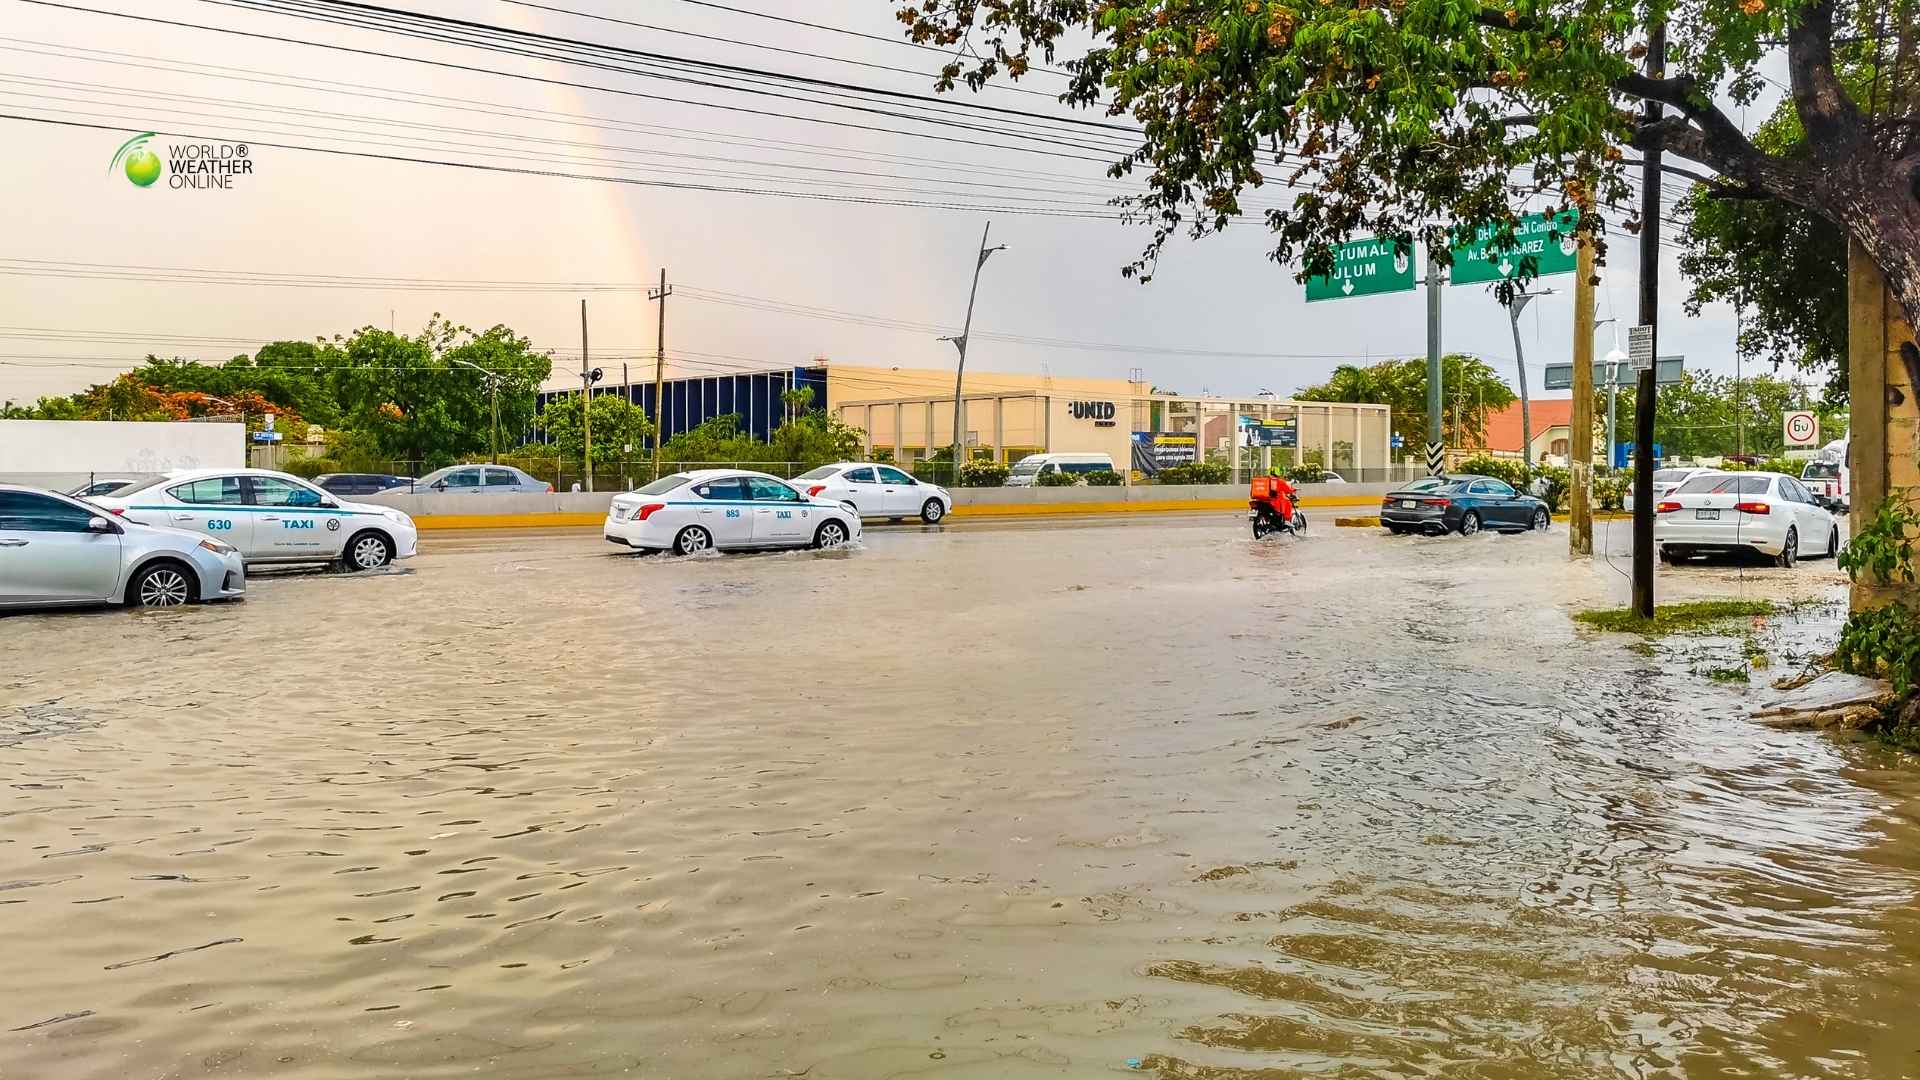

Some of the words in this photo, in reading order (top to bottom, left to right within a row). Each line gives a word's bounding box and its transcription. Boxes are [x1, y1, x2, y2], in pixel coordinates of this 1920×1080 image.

[1333, 244, 1389, 262] TUMAL
[1468, 249, 1480, 261] Av.
[1333, 262, 1377, 280] ULUM
[776, 510, 792, 519] TAXI
[207, 519, 232, 530] 630
[281, 519, 314, 529] TAXI
